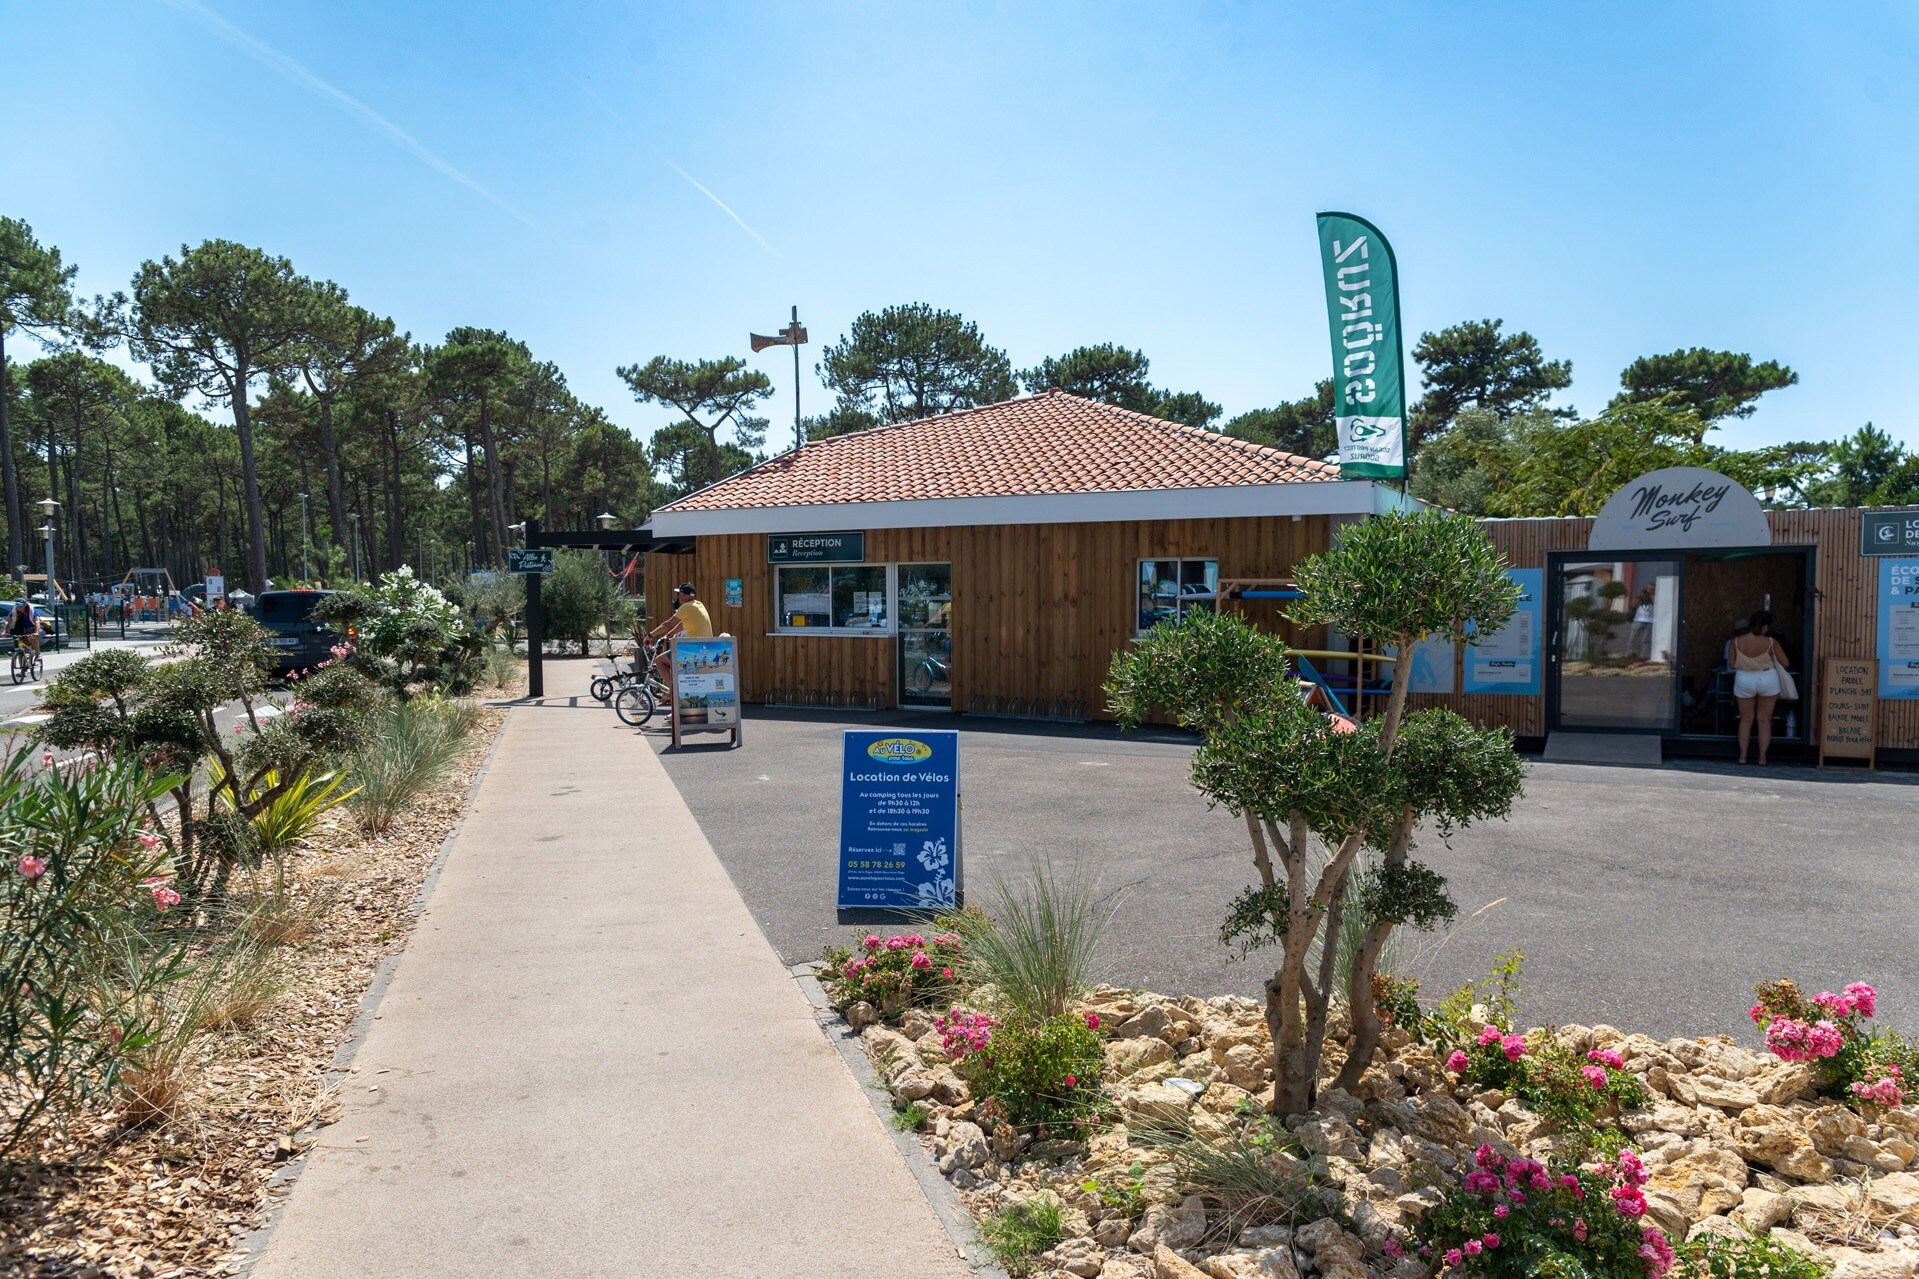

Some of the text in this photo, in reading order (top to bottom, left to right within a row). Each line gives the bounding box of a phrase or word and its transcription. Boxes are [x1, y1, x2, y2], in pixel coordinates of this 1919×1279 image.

[1630, 481, 1731, 520] Monkey
[1645, 505, 1702, 532] Surf
[792, 538, 842, 548] RÉCEPTION
[792, 549, 824, 558] Reception
[1891, 576, 1910, 585] DE
[1890, 586, 1900, 595] &
[1836, 665, 1868, 675] LOCATION
[1841, 677, 1863, 685] PADDLE
[885, 741, 915, 754] VÉLO
[850, 772, 950, 782] Location de Vélos
[884, 861, 894, 869] 26
[895, 861, 906, 869] 59
